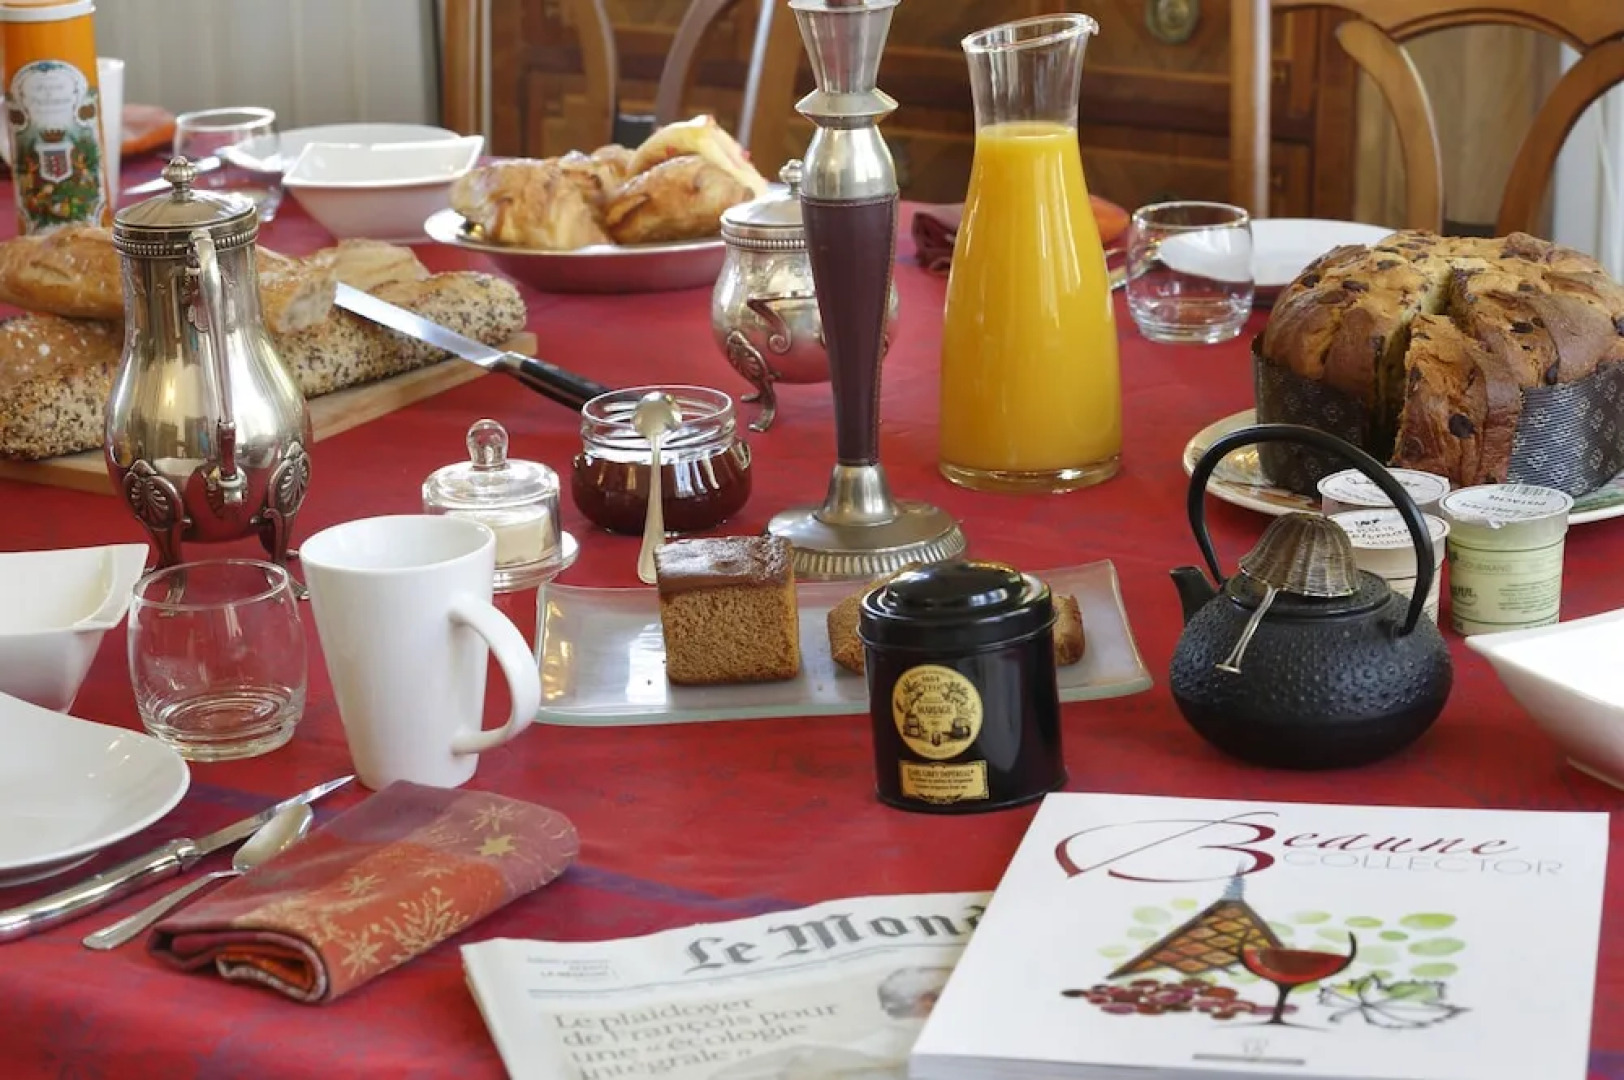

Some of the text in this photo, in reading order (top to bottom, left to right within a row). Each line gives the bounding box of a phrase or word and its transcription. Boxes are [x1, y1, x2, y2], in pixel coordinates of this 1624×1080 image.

[1054, 811, 1519, 882] Beaune
[1282, 850, 1563, 877] COLLECTOR
[684, 904, 987, 974] Le Mon
[554, 999, 753, 1032] Le plaidoyer
[563, 1030, 602, 1046] de
[759, 1003, 838, 1026] pour
[571, 1048, 638, 1063] une
